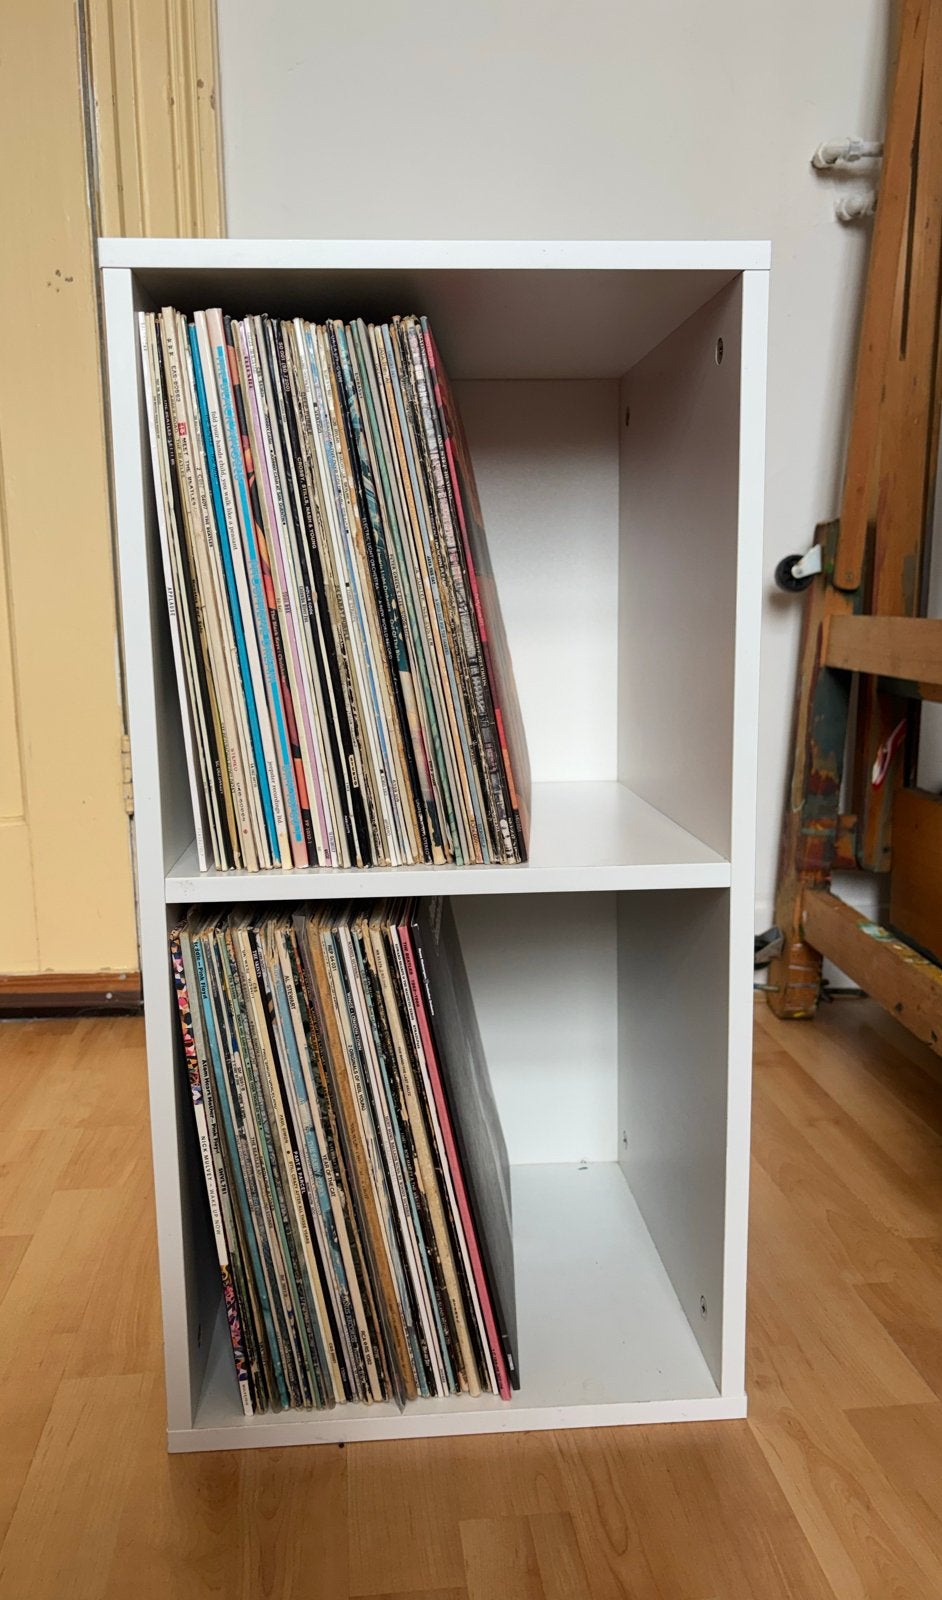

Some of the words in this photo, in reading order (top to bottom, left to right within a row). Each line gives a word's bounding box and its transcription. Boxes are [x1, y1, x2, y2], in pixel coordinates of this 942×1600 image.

[215, 357, 226, 378] THE
[219, 381, 234, 427] BLACK
[214, 439, 223, 458] hands
[217, 459, 226, 477] child,
[296, 456, 305, 482] CROSBY,
[220, 478, 228, 490] you
[223, 491, 231, 506] walk
[225, 507, 233, 519] like
[205, 527, 213, 547] BEATLES
[228, 526, 237, 550] peasant
[361, 517, 370, 540] ELECTRIC
[369, 559, 379, 589] ORCHESTRA
[166, 587, 175, 616] APPLAUSE
[340, 617, 349, 640] PURPLE
[267, 761, 276, 783] jeepster
[271, 784, 281, 814] recordings
[404, 952, 413, 975] BEATLES
[286, 984, 296, 1009] STEWART
[345, 992, 353, 1008] WINGS
[350, 1012, 358, 1034] LONDON
[354, 1035, 362, 1050] TOWN
[348, 1048, 358, 1073] ORIGINALS
[358, 1094, 366, 1111] YOUNG
[206, 1097, 215, 1118] Mother
[210, 1123, 218, 1137] Pink
[281, 1127, 289, 1143] SIMON
[212, 1137, 220, 1153] Floyd
[203, 1154, 212, 1180] MULVEY
[252, 1147, 260, 1167] BEATLES
[322, 1154, 330, 1169] YEAR
[297, 1172, 305, 1193] PARCEL
